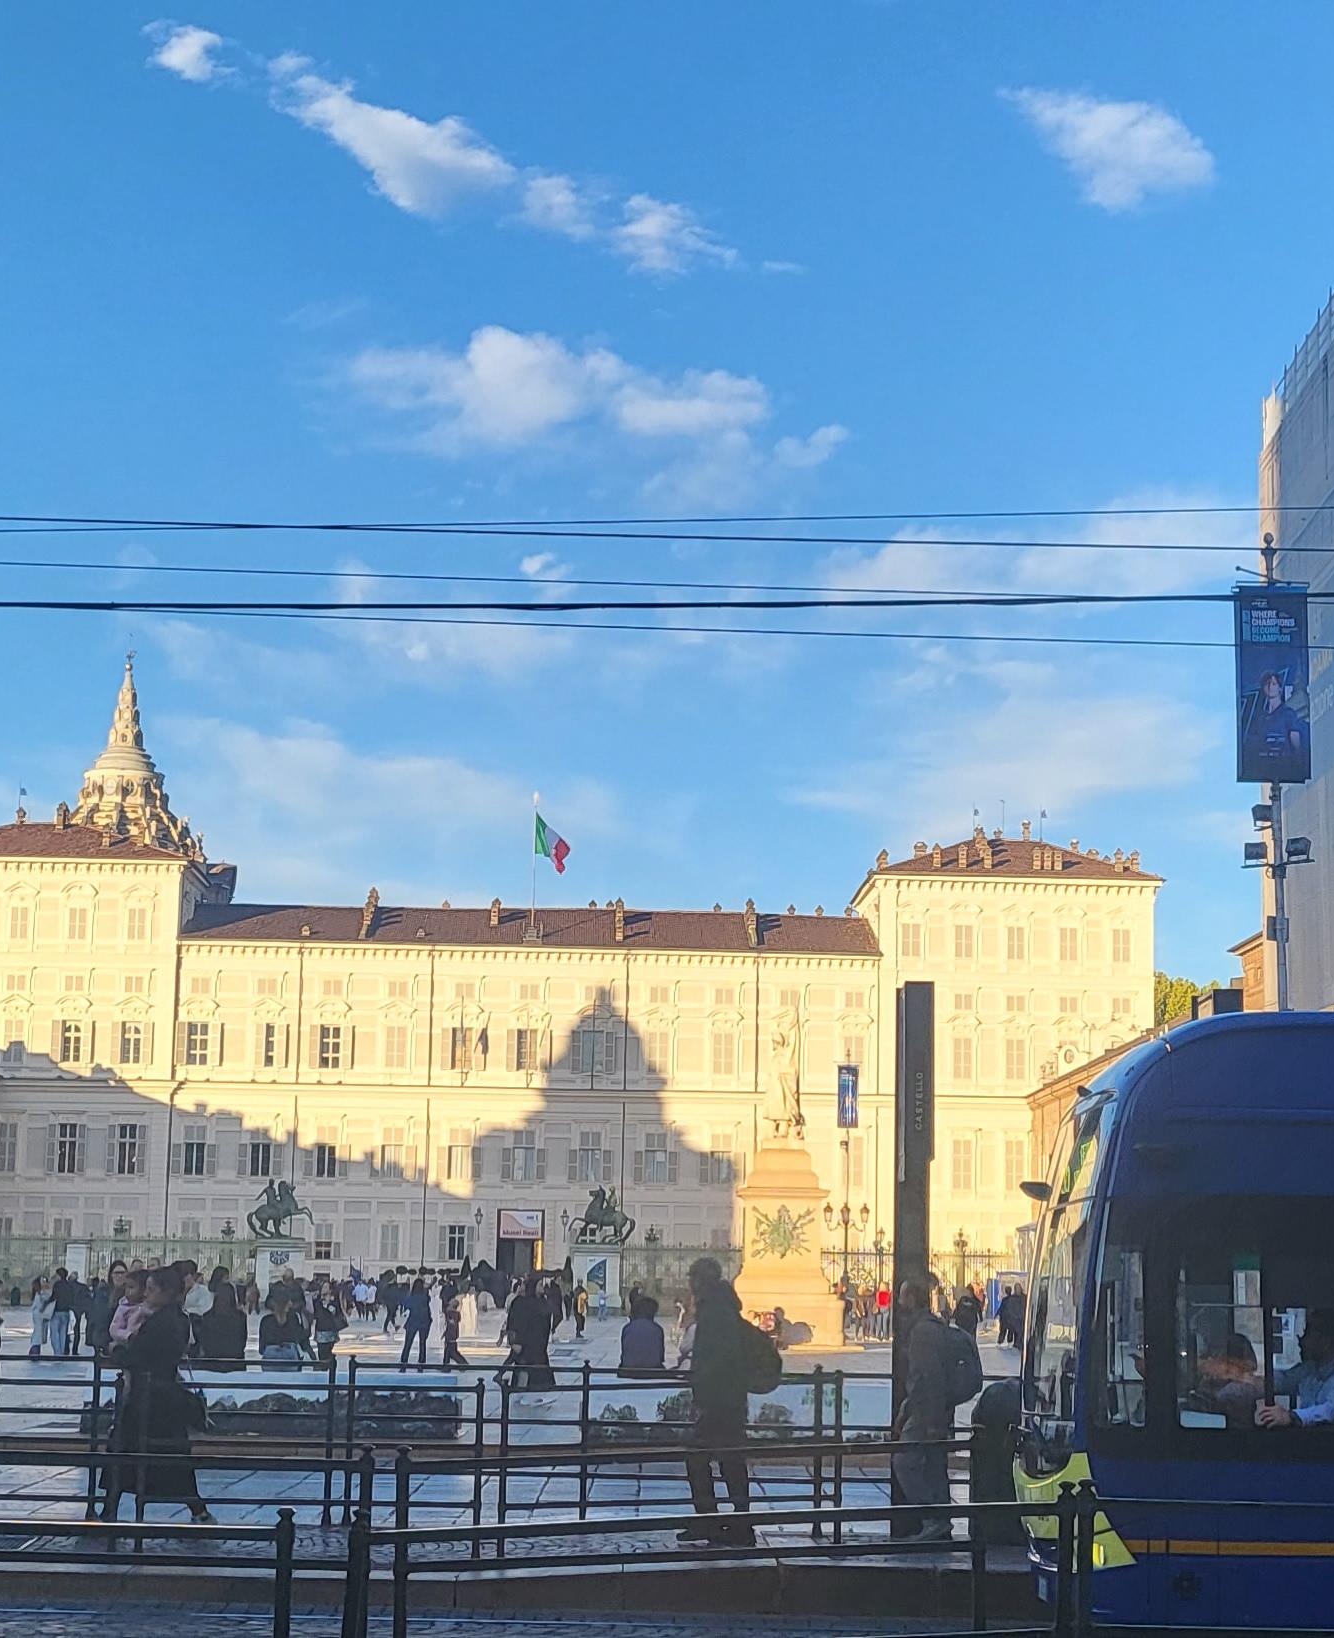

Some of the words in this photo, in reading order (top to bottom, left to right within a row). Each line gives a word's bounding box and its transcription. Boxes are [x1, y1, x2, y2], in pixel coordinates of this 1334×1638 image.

[1251, 610, 1277, 618] WHERE
[1251, 618, 1295, 627] CHAMPIONS
[1251, 626, 1280, 634] BECOME
[1251, 634, 1291, 643] CHAMPION
[914, 1072, 924, 1131] CASTELLO
